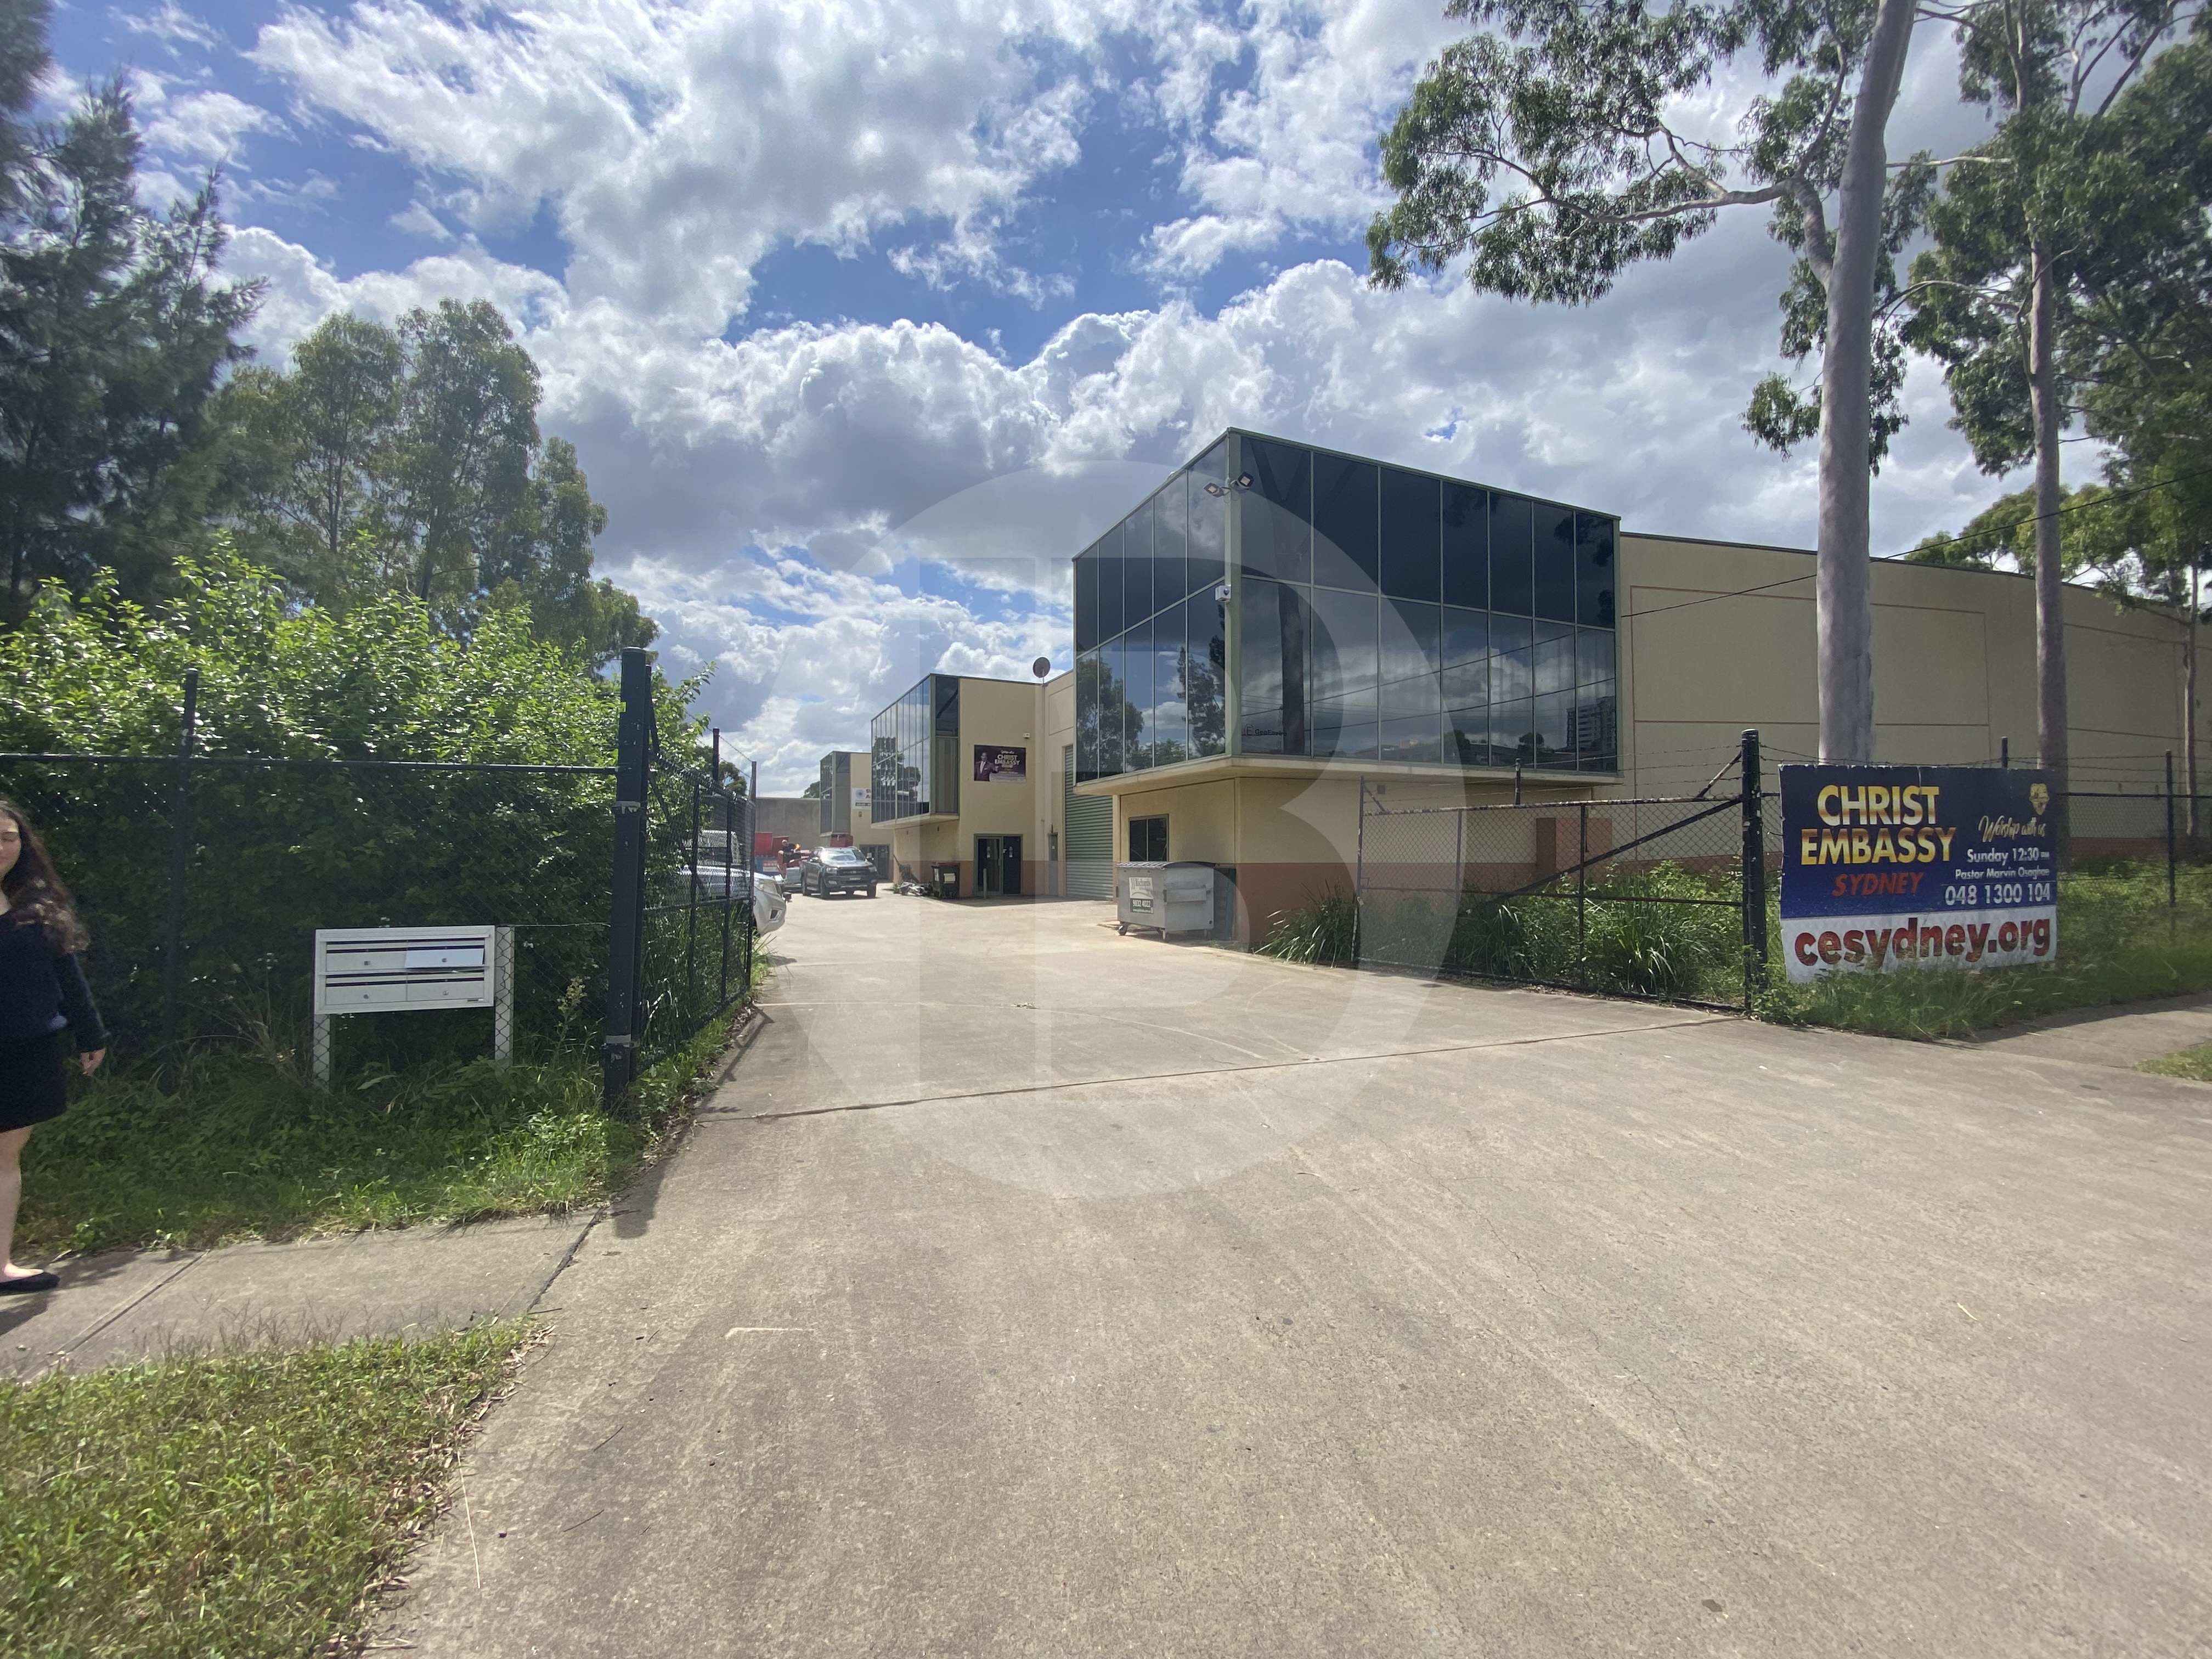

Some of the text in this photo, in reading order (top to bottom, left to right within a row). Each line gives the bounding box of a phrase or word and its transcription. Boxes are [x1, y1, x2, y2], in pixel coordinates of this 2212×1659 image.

[1817, 785, 1940, 826] CHRIST
[1978, 815, 2020, 843] Worship
[1801, 826, 1957, 865] EMBASSY
[1967, 847, 2009, 866] Sunday
[2012, 847, 2039, 861] 12:30
[1831, 872, 1925, 898] SYDNEY
[1955, 868, 1984, 879] Pastor
[1987, 866, 2016, 878] Marvin
[1945, 882, 2050, 906] 048 1300 104
[1795, 917, 2050, 969] cesydney.org
